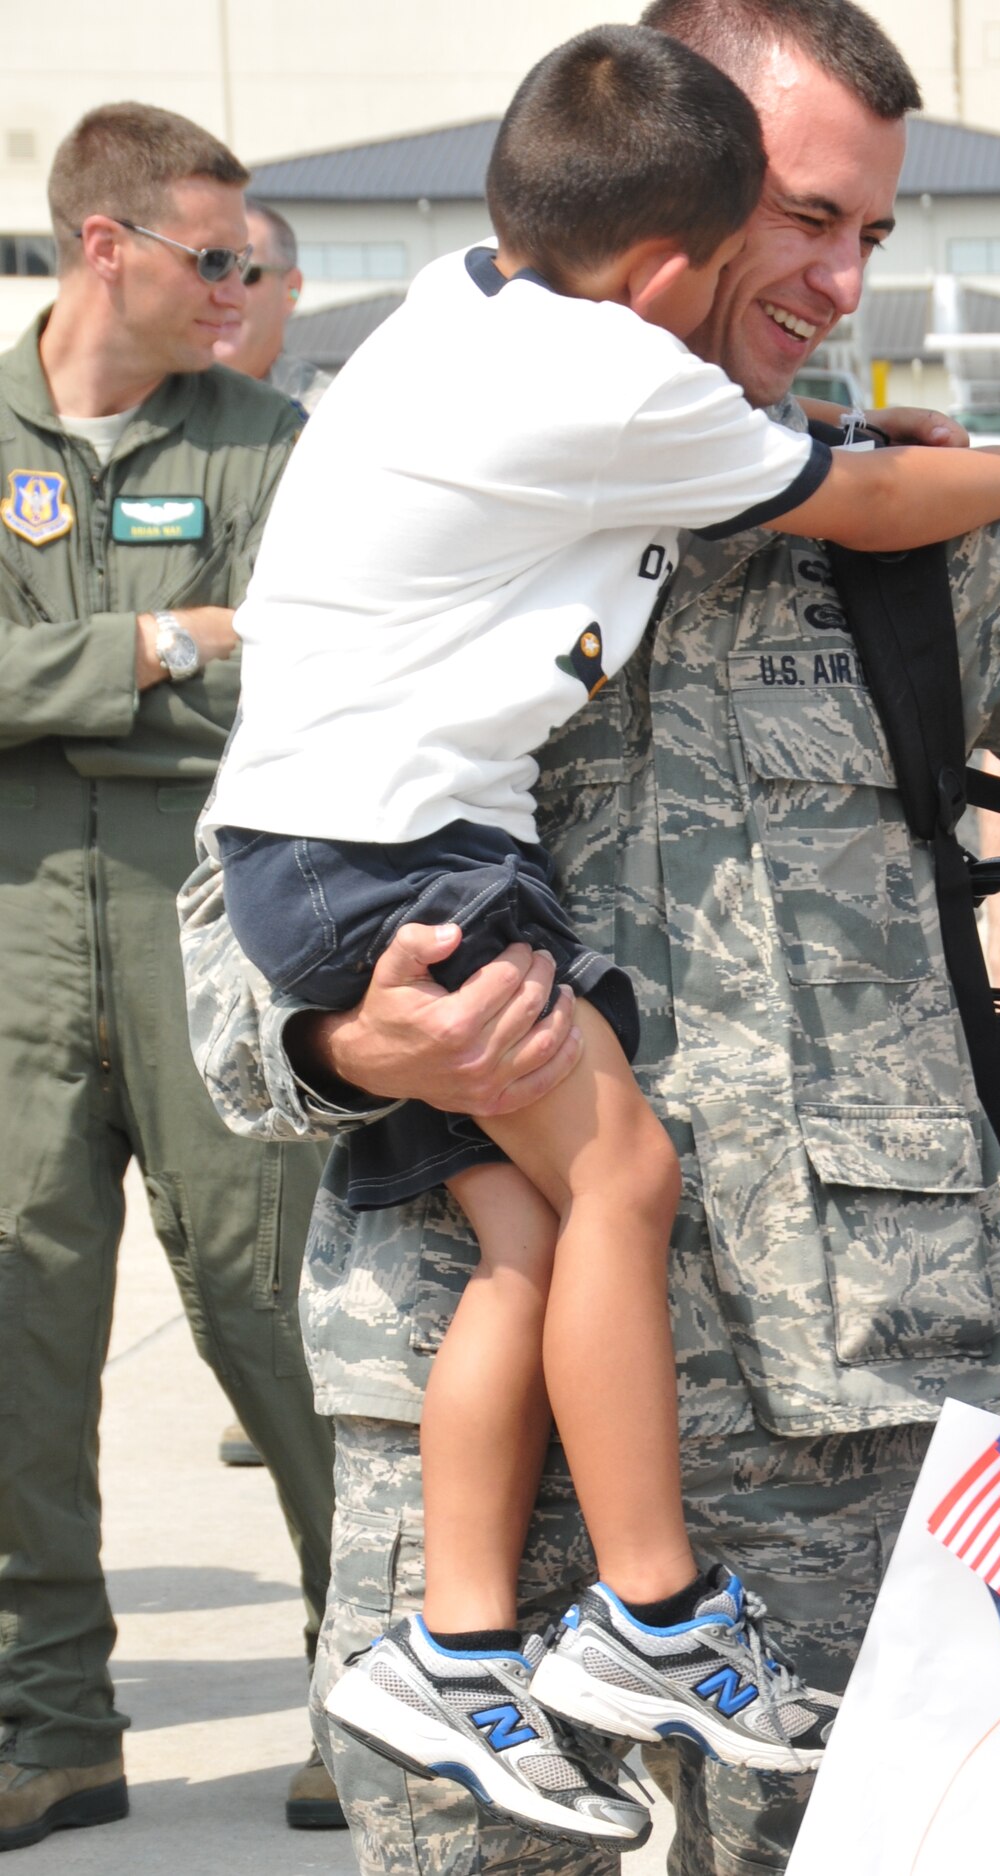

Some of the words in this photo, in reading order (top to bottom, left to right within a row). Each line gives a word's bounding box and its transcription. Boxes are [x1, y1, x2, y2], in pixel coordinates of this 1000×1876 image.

[760, 655, 805, 686] U.S.
[813, 653, 853, 685] AIR
[689, 1663, 760, 1720] N
[469, 1702, 541, 1753] N
